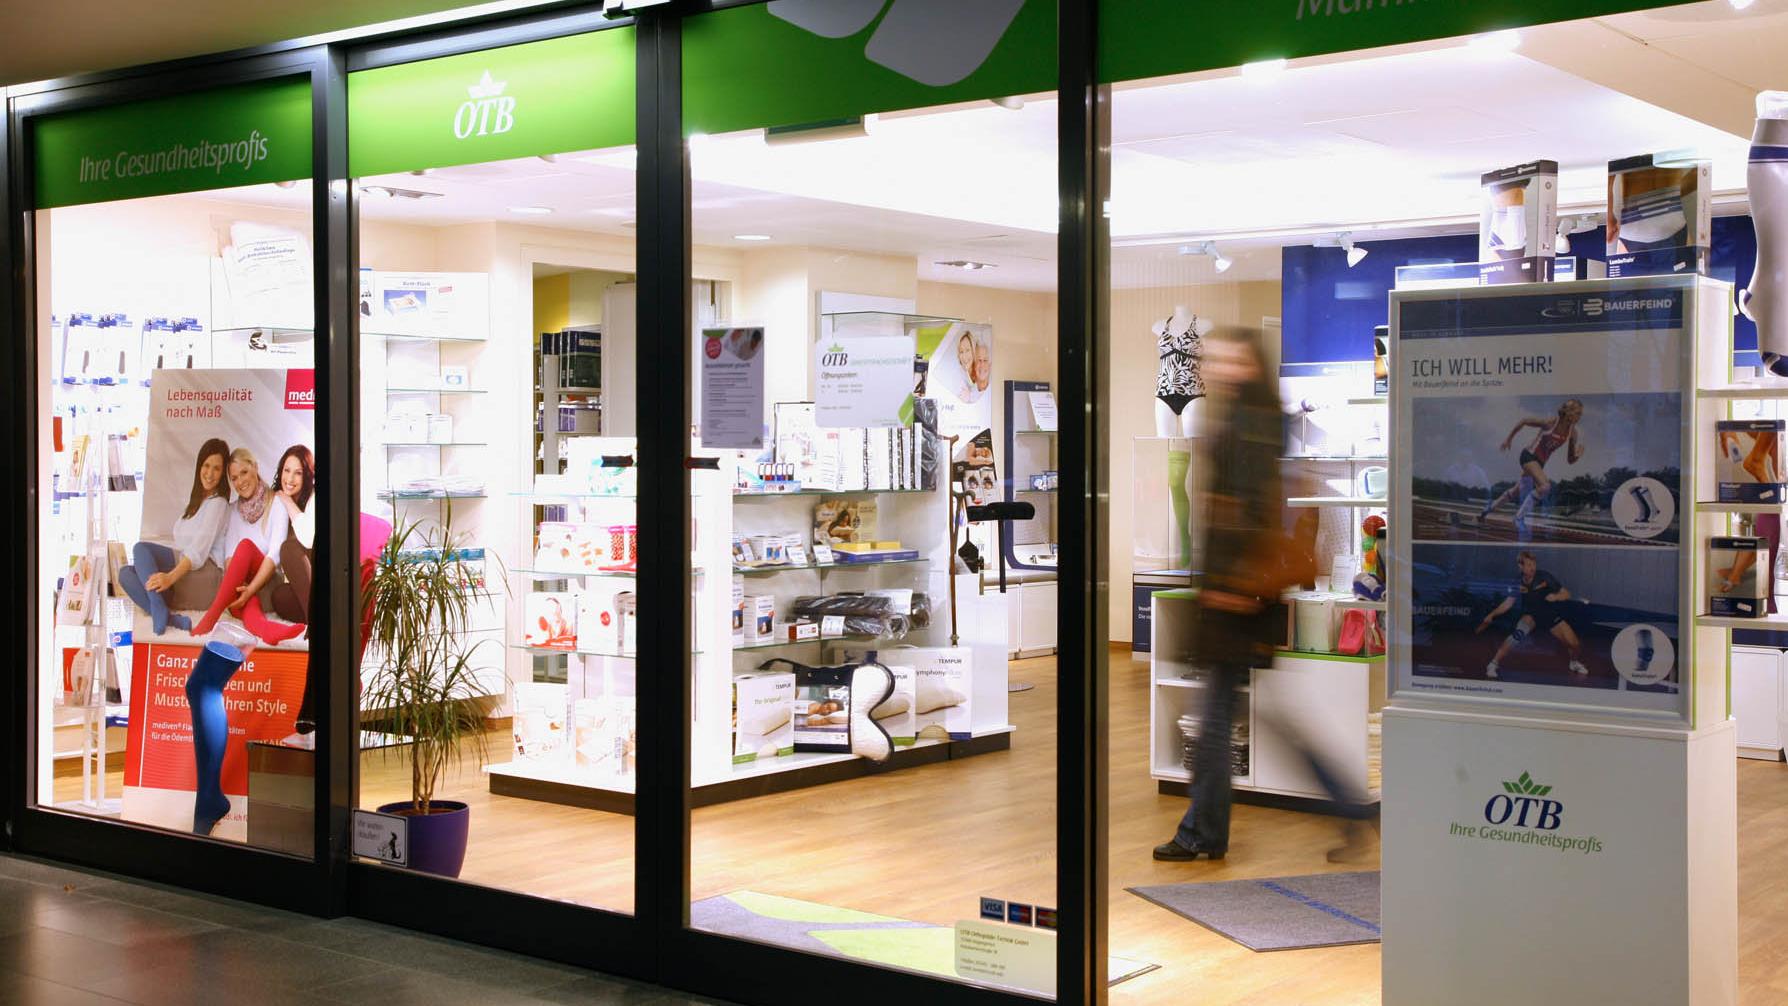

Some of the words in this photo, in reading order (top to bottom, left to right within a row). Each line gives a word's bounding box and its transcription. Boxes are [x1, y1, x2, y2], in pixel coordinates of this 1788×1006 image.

[454, 96, 516, 139] OTB
[79, 156, 110, 183] Ihre
[115, 130, 268, 178] Gesundheitsprofis
[822, 352, 848, 367] OTB
[1411, 359, 1442, 377] ICH
[1449, 357, 1492, 376] WILL
[1498, 355, 1552, 375] MEHR!
[167, 388, 253, 404] Lebensqualität
[166, 405, 193, 418] nach
[196, 405, 222, 418] Maß
[157, 653, 189, 669] Ganz
[248, 679, 272, 694] und
[256, 699, 288, 717] Style
[1484, 794, 1563, 830] OTB
[1450, 821, 1476, 837] Ihre
[1479, 825, 1603, 855] Gesundheitsprofis
[984, 901, 1002, 912] VISA
